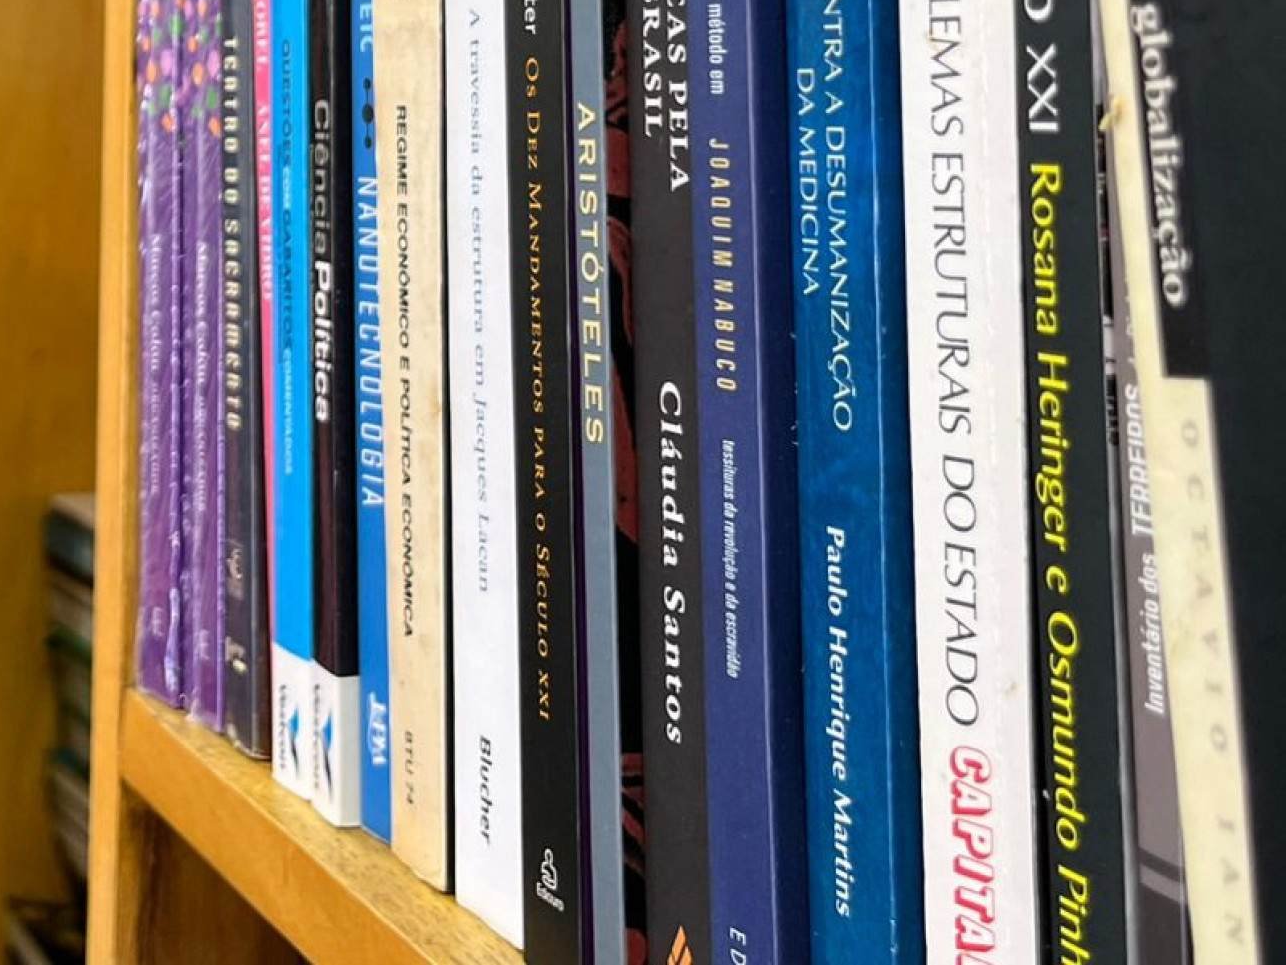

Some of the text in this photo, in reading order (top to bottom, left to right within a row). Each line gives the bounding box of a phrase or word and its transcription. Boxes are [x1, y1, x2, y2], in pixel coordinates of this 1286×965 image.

[668, 80, 691, 193] PELA
[707, 4, 728, 65] método
[709, 69, 723, 95] em
[825, 91, 843, 114] A
[1025, 42, 1061, 136] XXI
[224, 36, 242, 430] TEATRO DO SACRAMENTO
[708, 137, 737, 394] JOAQUIM NABUCO
[796, 67, 819, 295] DA MEDICINA
[1030, 163, 1062, 334] Rosana
[1128, 3, 1192, 307] globalização
[357, 175, 384, 508] NANOTECNOLOGIA
[395, 104, 416, 637] REGIME ECONÔMICO E POLÍTICA ECONÔMICA
[469, 9, 492, 592] A travessia da estrutura em Jacques Lacan
[577, 101, 603, 443] ARISTÓTELES
[822, 126, 855, 431] DESUMANIZAÇÃO
[931, 152, 973, 435] ESTRUTURAIS
[659, 381, 686, 745] Cláudia Santos
[722, 440, 742, 678] tessituras da revolução e da escravidão
[942, 454, 978, 532] DO
[1032, 352, 1072, 552] Heringer
[943, 542, 980, 727] ESTADO
[1045, 565, 1067, 594] e
[1138, 552, 1159, 594] dos
[1141, 598, 1164, 716] Inventário
[1180, 420, 1230, 756] OCTAVIO
[479, 735, 495, 847] Blucher
[537, 670, 549, 720] XXI
[825, 526, 854, 917] Paulo Henrique Martins
[1047, 612, 1085, 849] Osmundo
